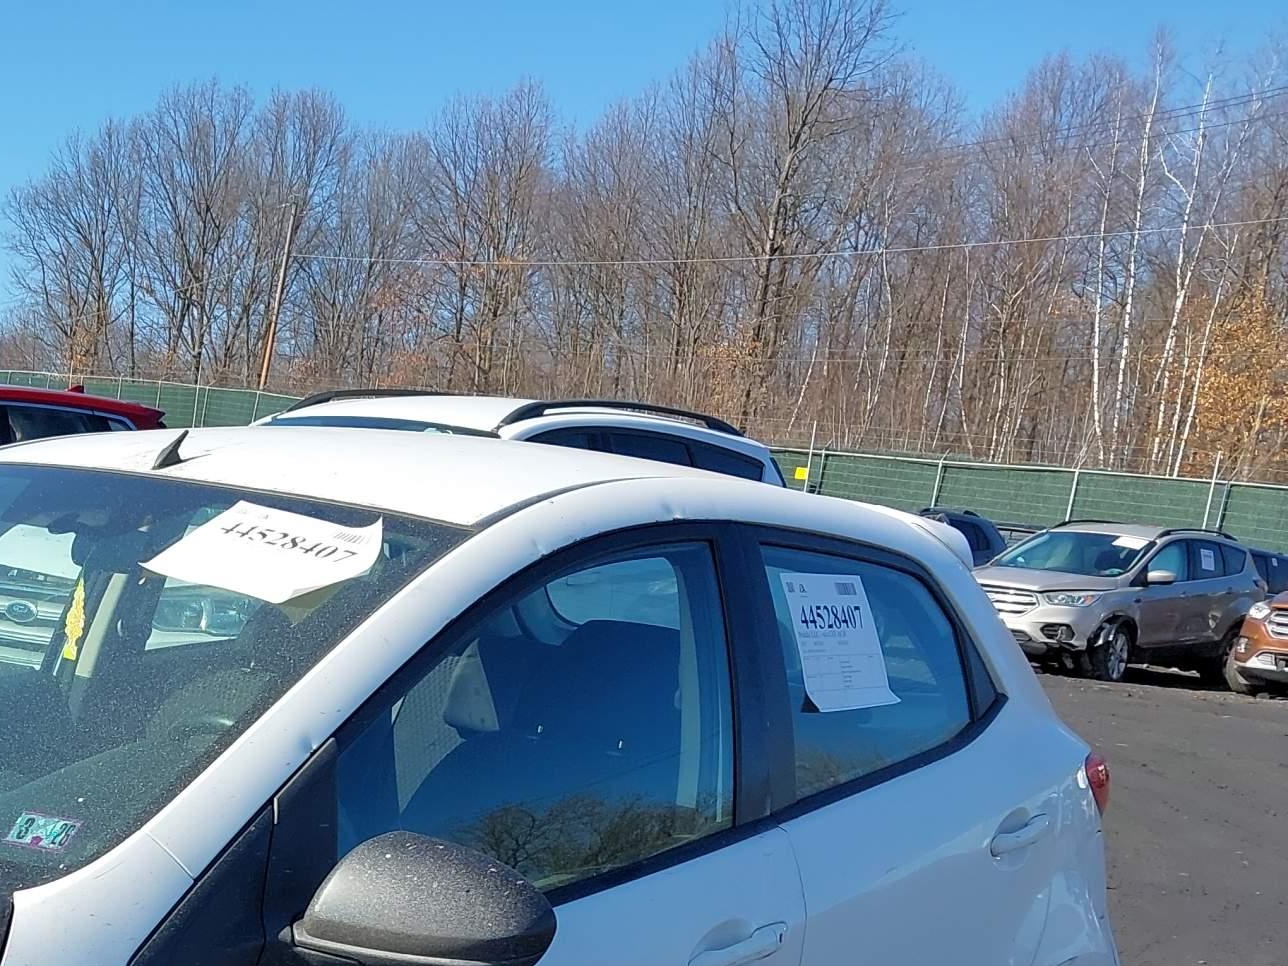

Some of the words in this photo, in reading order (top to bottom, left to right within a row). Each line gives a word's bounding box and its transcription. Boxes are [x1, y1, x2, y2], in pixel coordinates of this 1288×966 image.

[220, 522, 358, 563] 44528407
[800, 604, 863, 629] 44528407
[16, 817, 36, 840] 3
